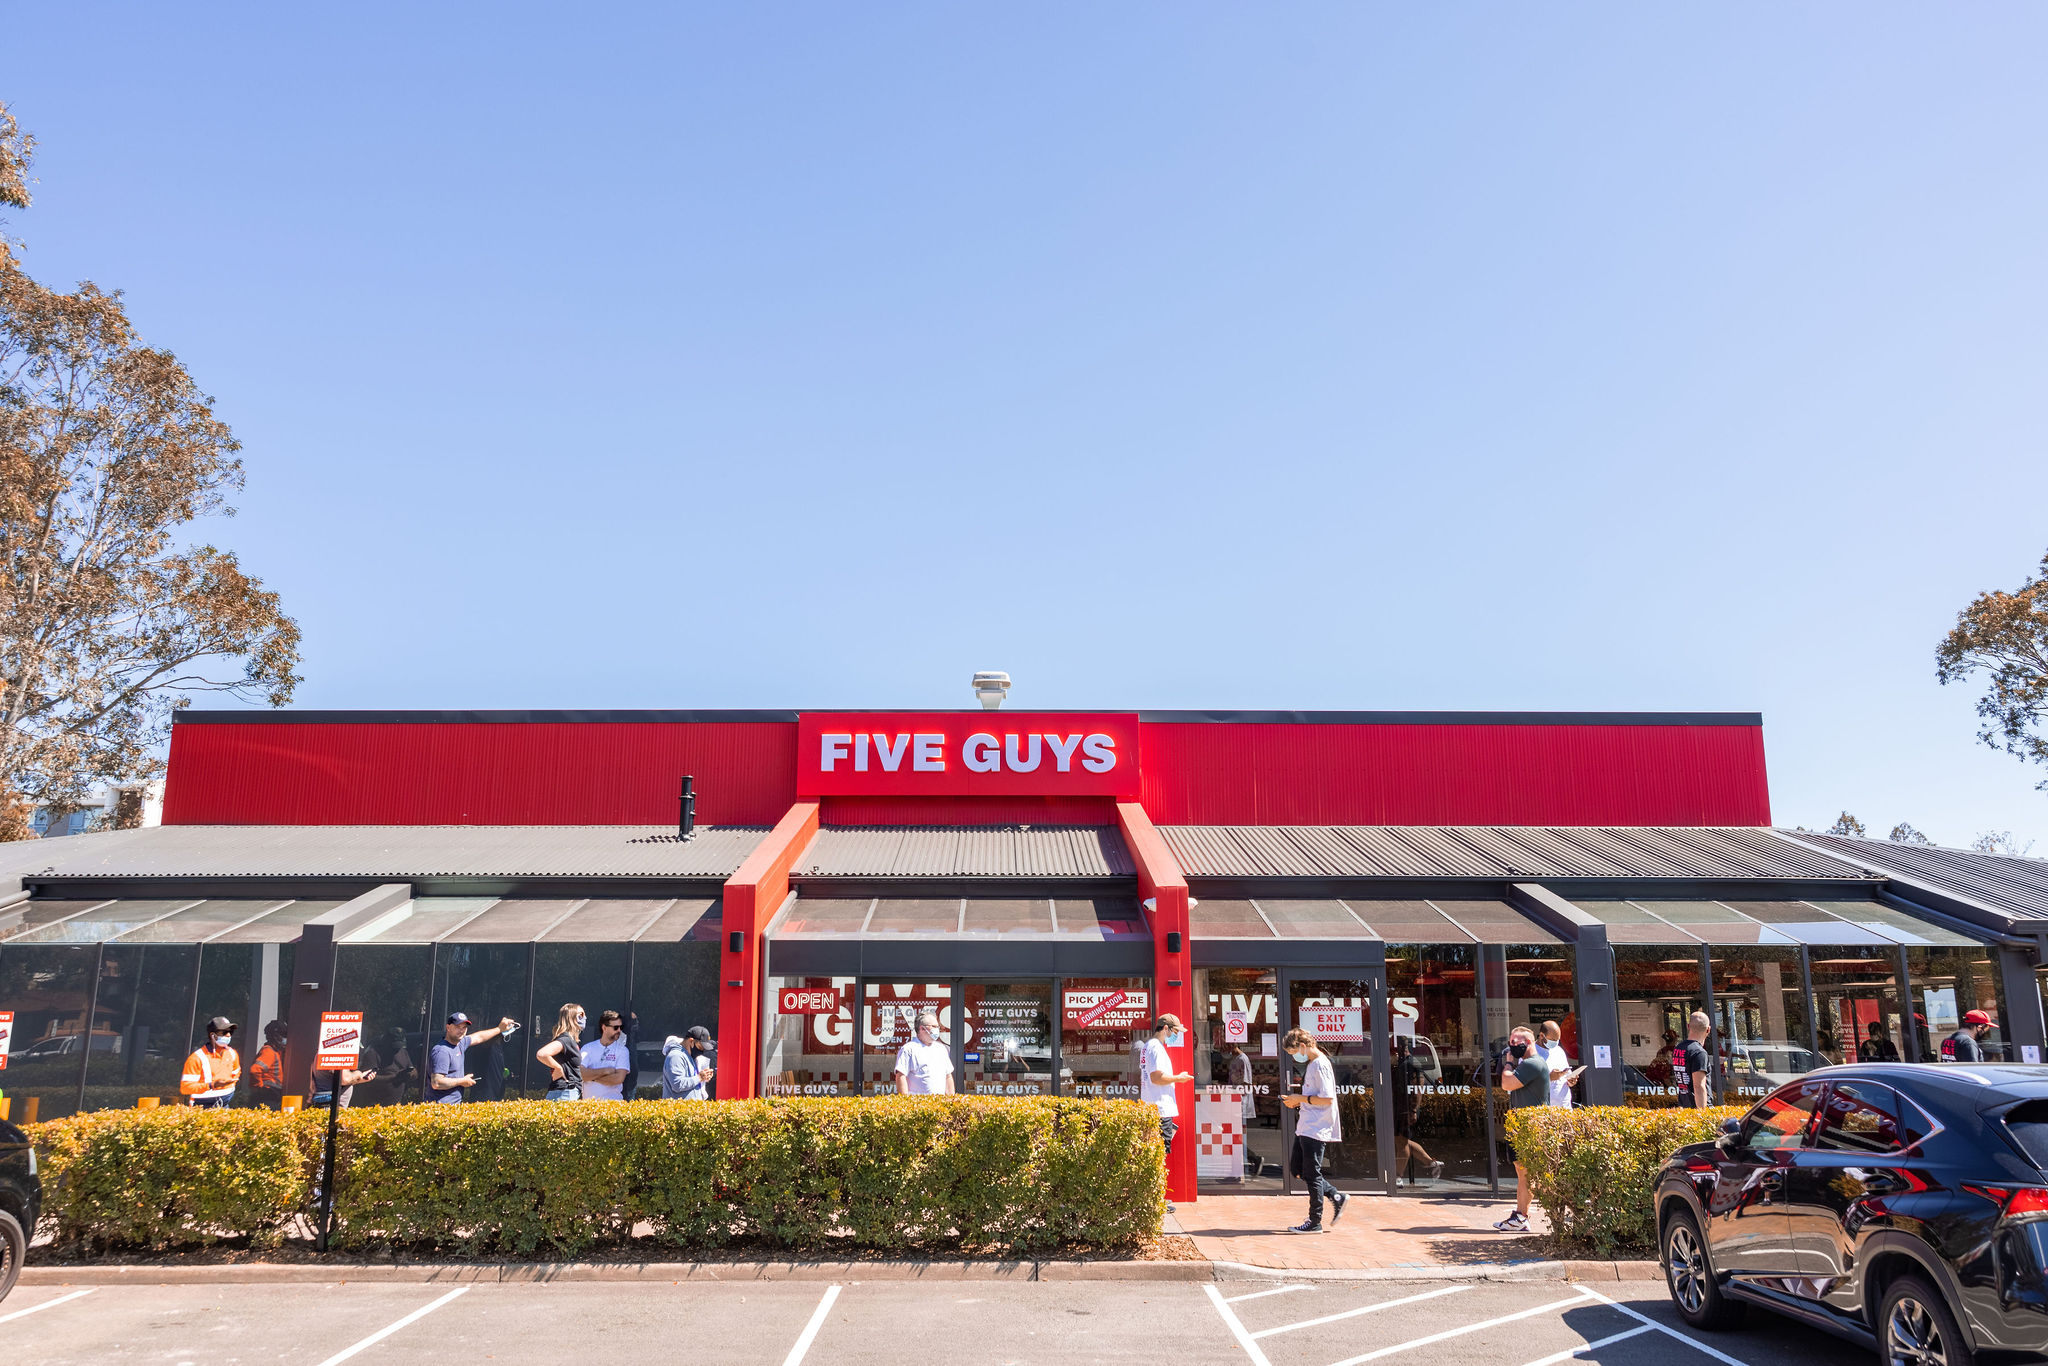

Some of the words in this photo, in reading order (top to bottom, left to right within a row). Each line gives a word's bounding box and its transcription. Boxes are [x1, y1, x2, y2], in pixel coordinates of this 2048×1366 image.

[820, 733, 946, 772] FIVE
[962, 733, 1117, 773] GUYS
[784, 992, 835, 1009] OPEN
[1068, 996, 1094, 1004] PICK
[978, 1008, 1004, 1018] FIVE
[1006, 1008, 1038, 1018] GUYS
[1080, 1005, 1107, 1024] COMING
[1105, 993, 1124, 1009] SOON
[1104, 1011, 1146, 1019] COLLECT
[1317, 1014, 1345, 1022] EXIT
[1317, 1023, 1346, 1032] ONLY
[980, 1036, 1004, 1044] OPEN
[774, 1085, 801, 1095] FIVE
[804, 1084, 838, 1095] GUYS
[976, 1084, 1003, 1095] FIVE
[1006, 1084, 1040, 1095] GUYS
[1075, 1085, 1103, 1095] FIVE
[1105, 1085, 1140, 1095] GUYS
[1205, 1084, 1233, 1094] FIVE
[1235, 1084, 1270, 1095] GUYS
[1406, 1085, 1435, 1095] FIVE
[1436, 1085, 1471, 1095] GUYS
[1637, 1086, 1665, 1096] FIVE
[1737, 1086, 1766, 1096] FIVE
